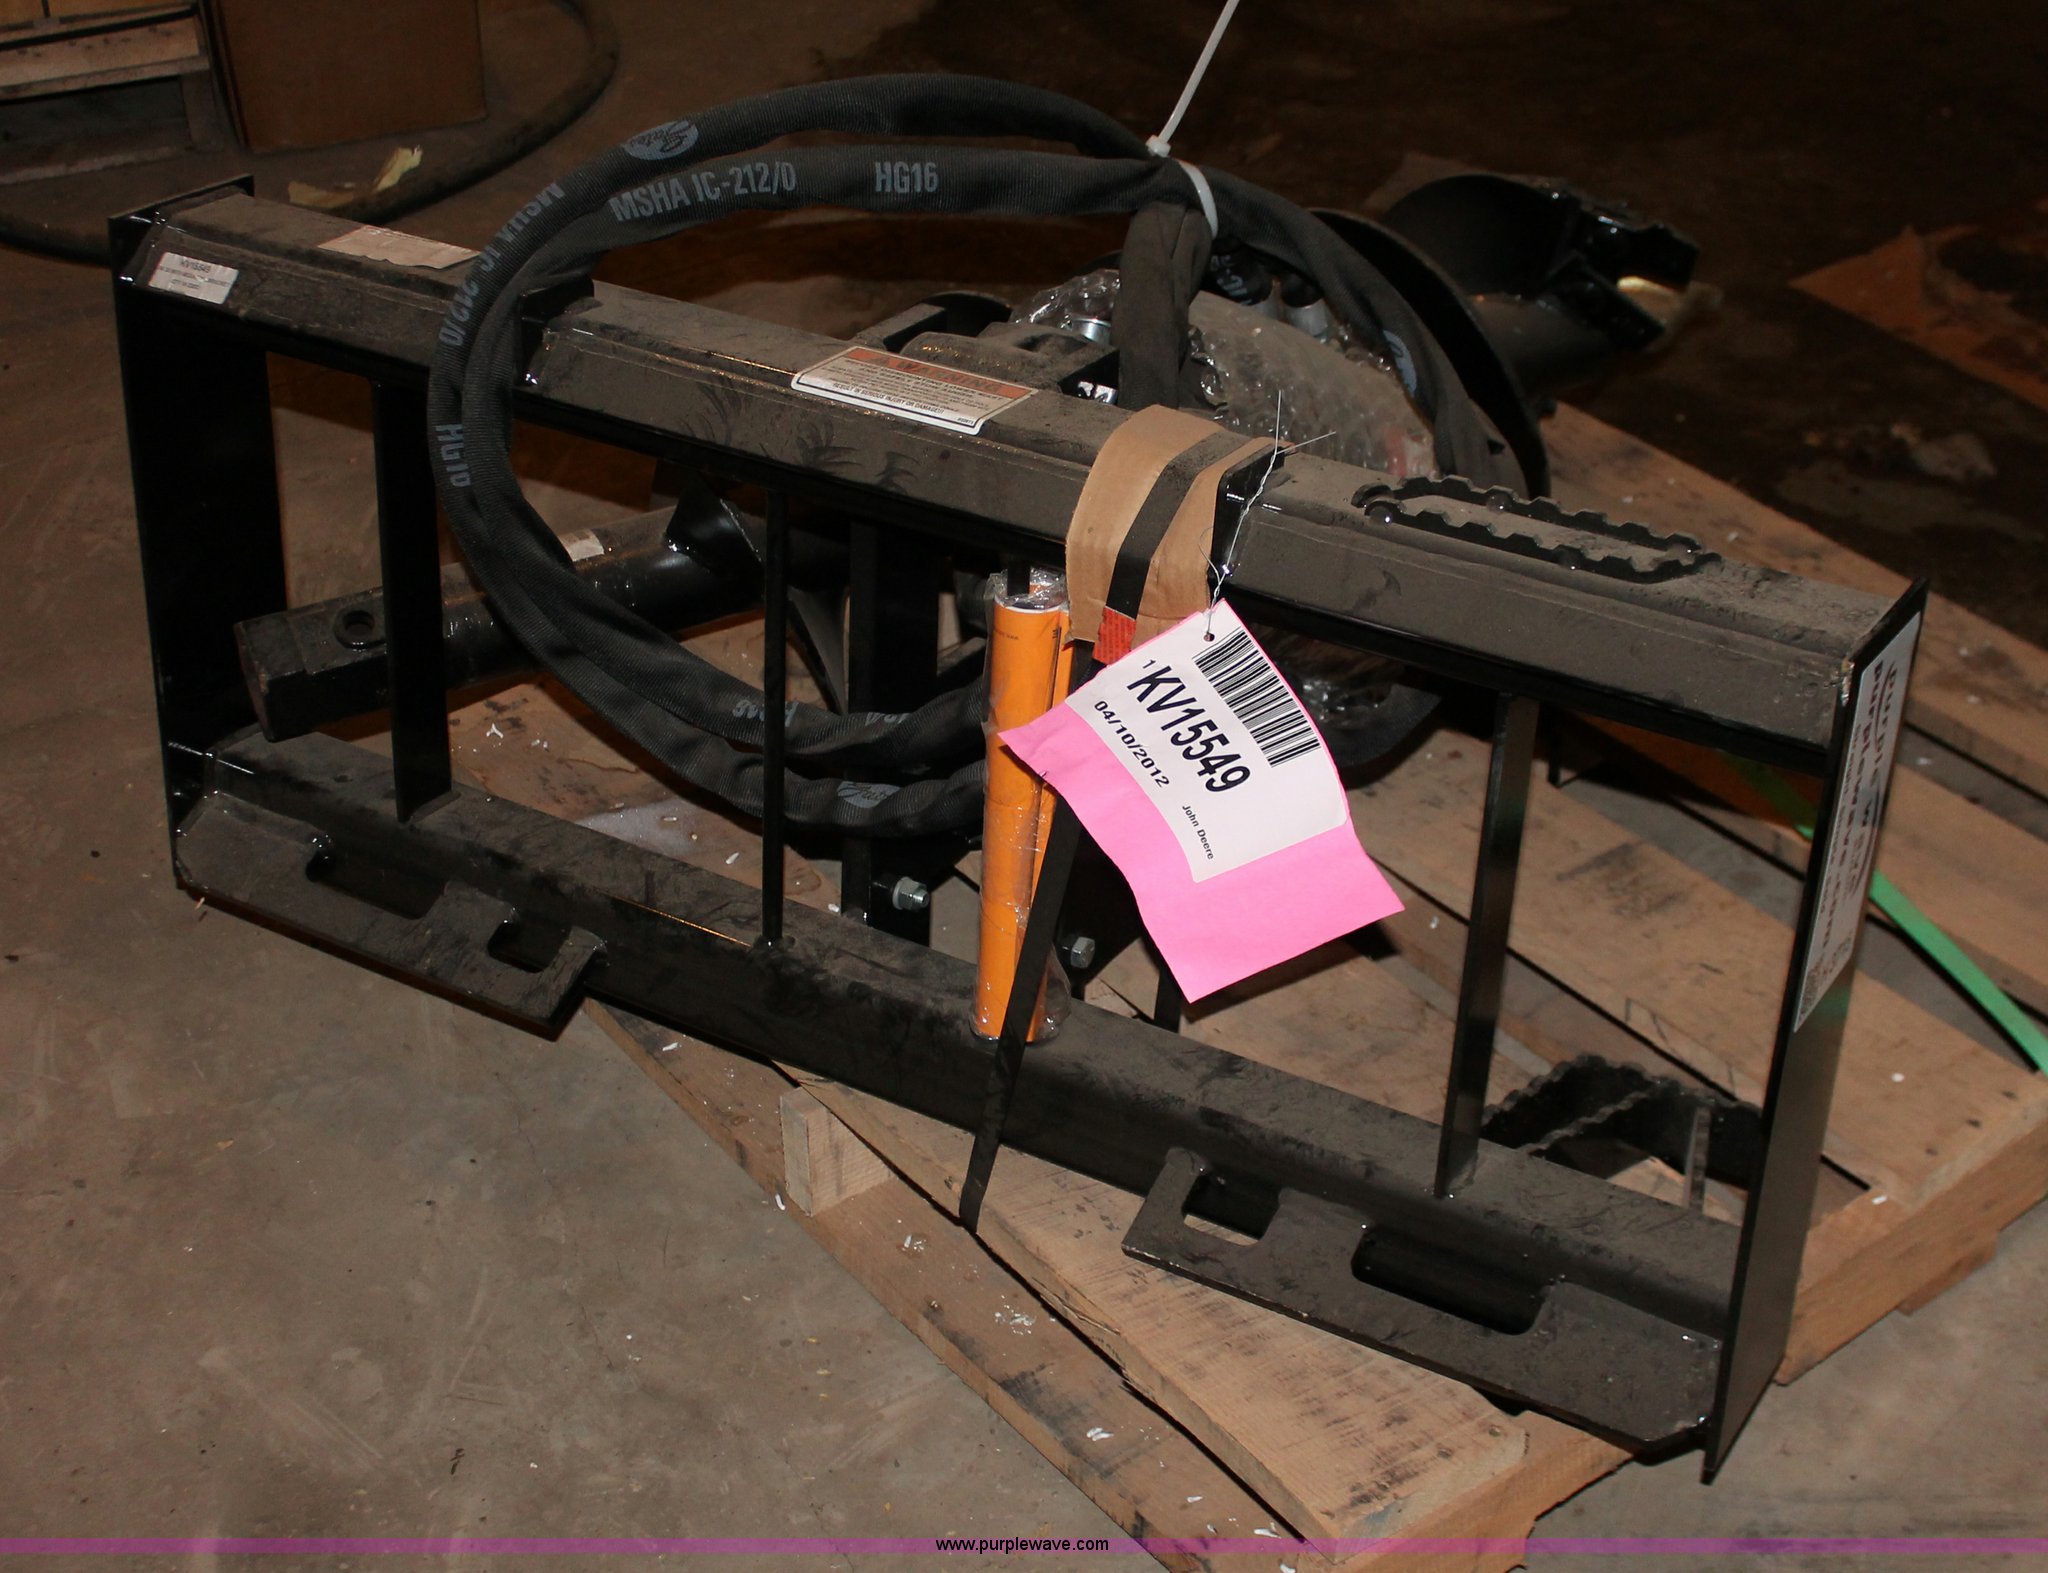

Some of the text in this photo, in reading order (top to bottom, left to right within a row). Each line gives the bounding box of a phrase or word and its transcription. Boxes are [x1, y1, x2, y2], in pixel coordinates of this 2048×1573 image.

[608, 177, 691, 222] MSHA
[875, 161, 939, 193] HG16
[1094, 700, 1170, 788] 04/10/2012
[1126, 665, 1251, 793] KV15549
[1182, 804, 1214, 860] John Deere
